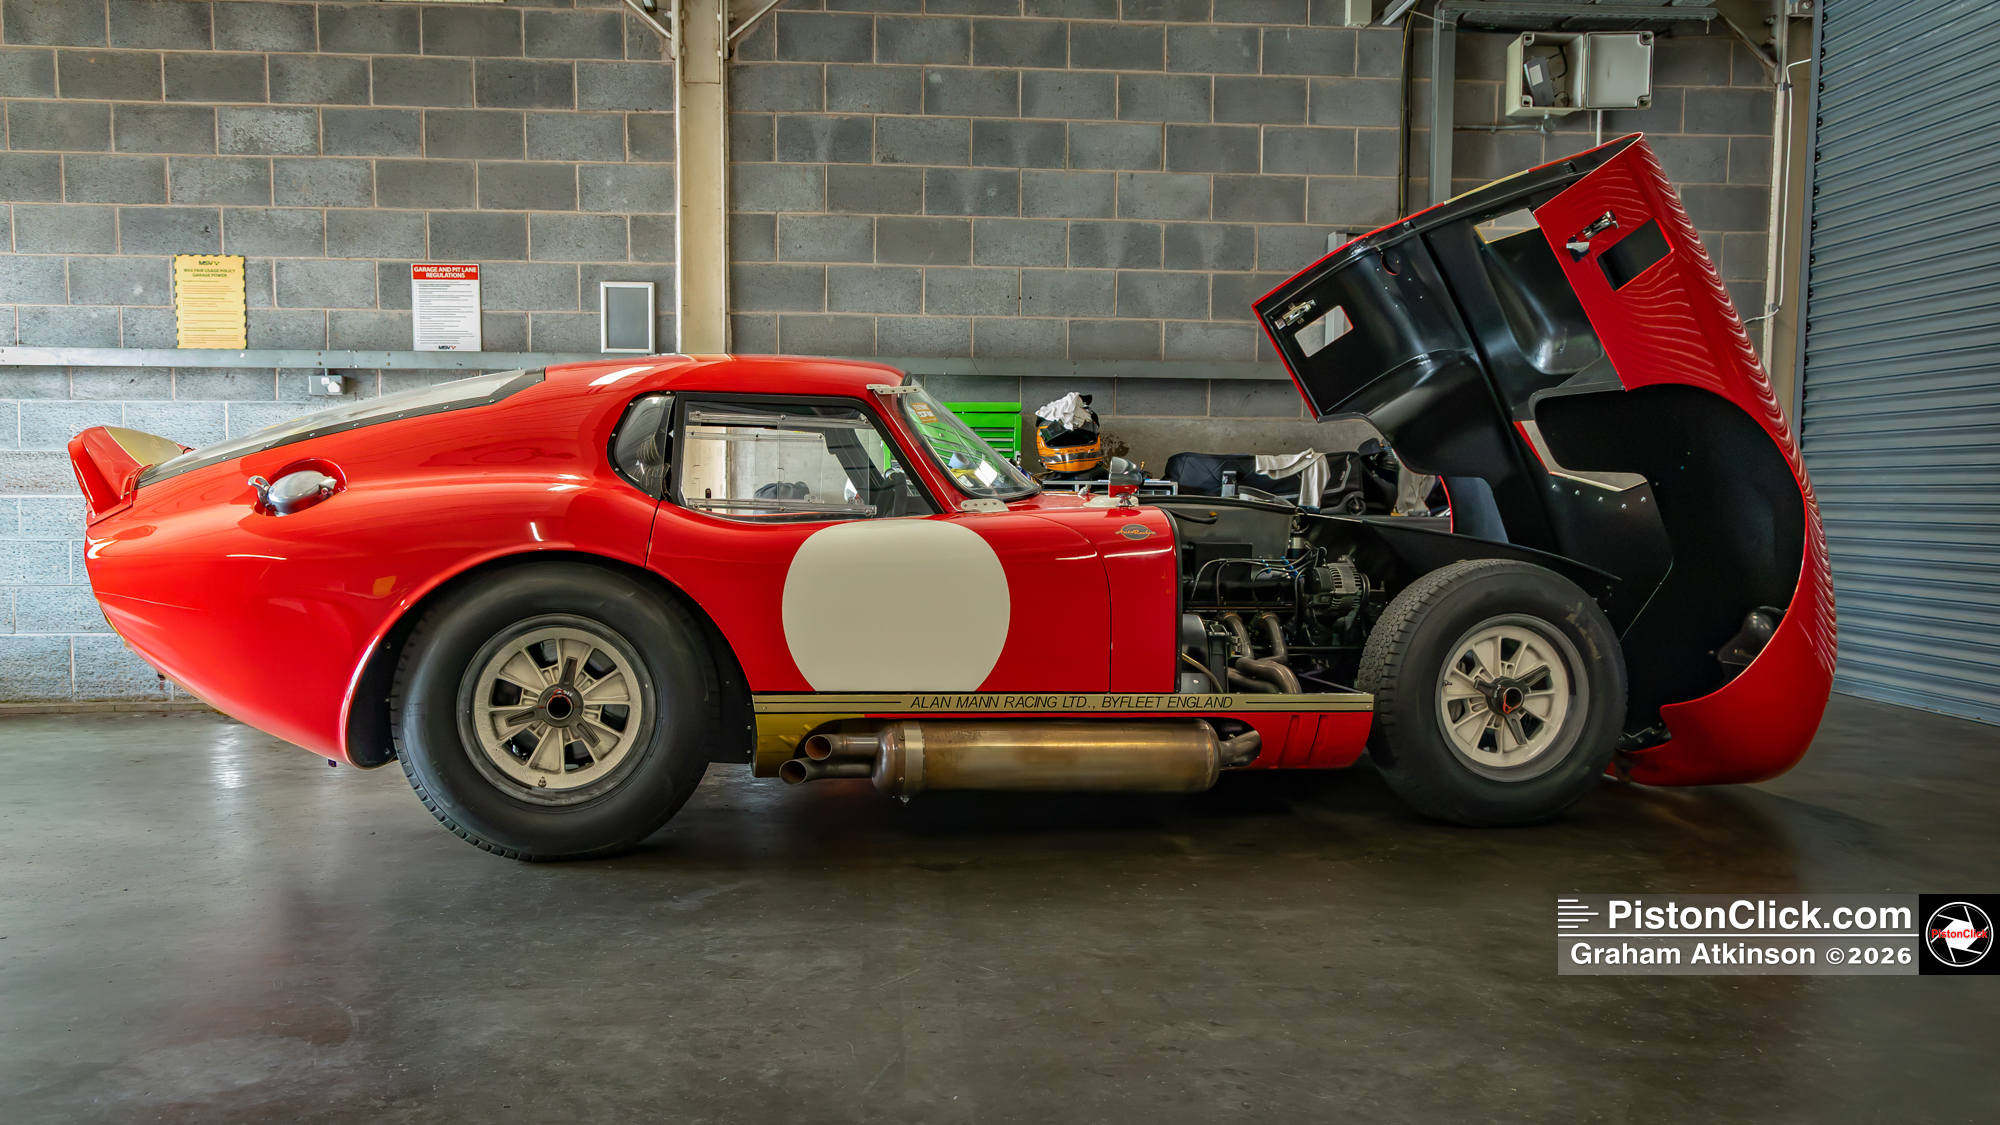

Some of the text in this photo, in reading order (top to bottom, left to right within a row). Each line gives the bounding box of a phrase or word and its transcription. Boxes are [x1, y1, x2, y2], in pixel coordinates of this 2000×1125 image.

[910, 696, 1233, 710] ALAN MANN RACING LTD., BYFLEET ENGLAND
